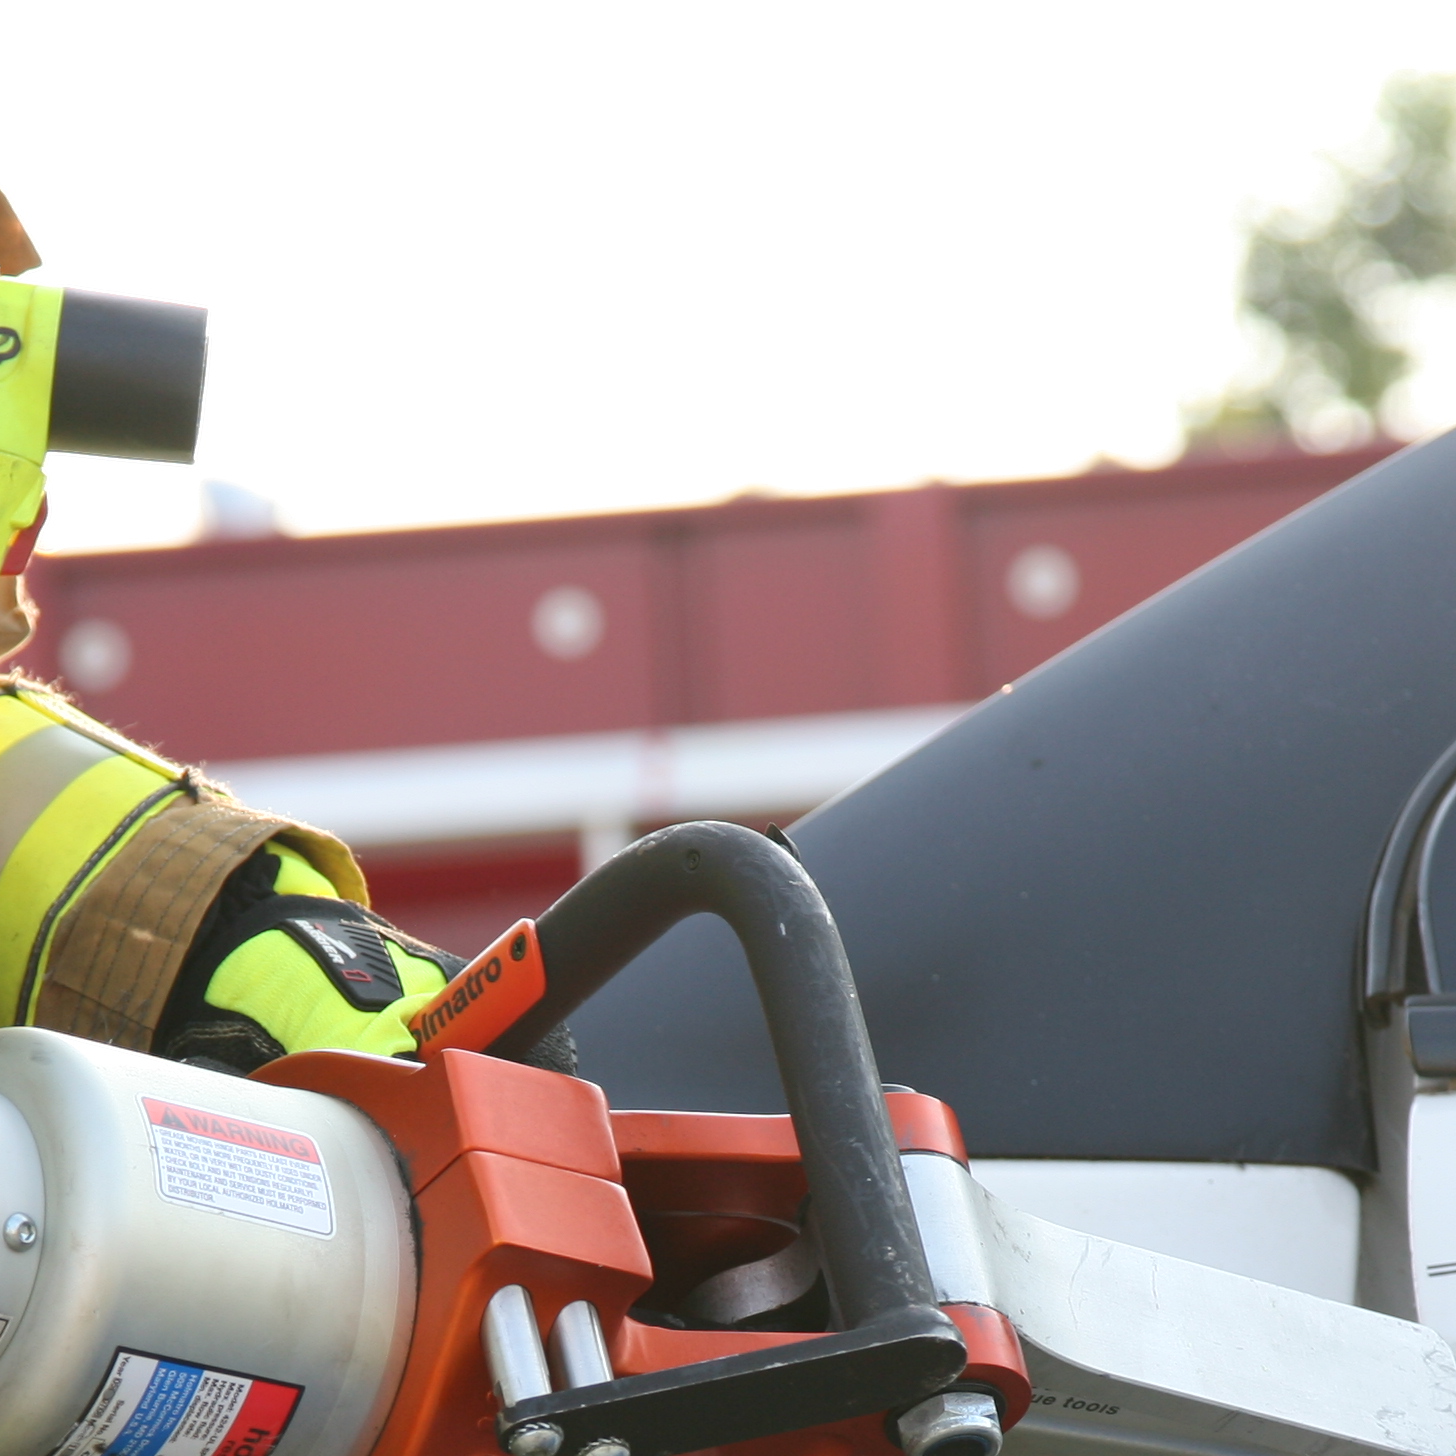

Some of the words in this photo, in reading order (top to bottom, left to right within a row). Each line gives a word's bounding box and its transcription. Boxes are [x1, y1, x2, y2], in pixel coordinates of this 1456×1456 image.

[409, 956, 502, 1046] olmatro
[185, 1113, 310, 1158] WARNING
[165, 1156, 187, 1167] CHECK
[189, 1161, 205, 1171] BOLT
[207, 1166, 221, 1175] AND
[166, 1165, 213, 1183] MAINTENANCE
[214, 1177, 228, 1186] AND
[167, 1174, 176, 1183] BY
[178, 1178, 197, 1189] YOUR
[199, 1181, 220, 1195] LOCAL
[222, 1187, 264, 1206] AUTHORIZED
[266, 1198, 304, 1214] HOLMATRO
[117, 1356, 131, 1377] Year
[141, 1367, 167, 1410] Maryland
[162, 1370, 176, 1391] Glen
[204, 1378, 220, 1399] Max.
[221, 1382, 236, 1401] Max.
[172, 1374, 198, 1416] Holmatro
[204, 1380, 228, 1420] Hydraulic
[228, 1384, 245, 1412] Model:
[106, 1400, 125, 1423] Serial
[146, 1390, 180, 1438] McCormick
[195, 1401, 209, 1419] flow
[1063, 1397, 1121, 1416] tools
[134, 1424, 148, 1439] MD
